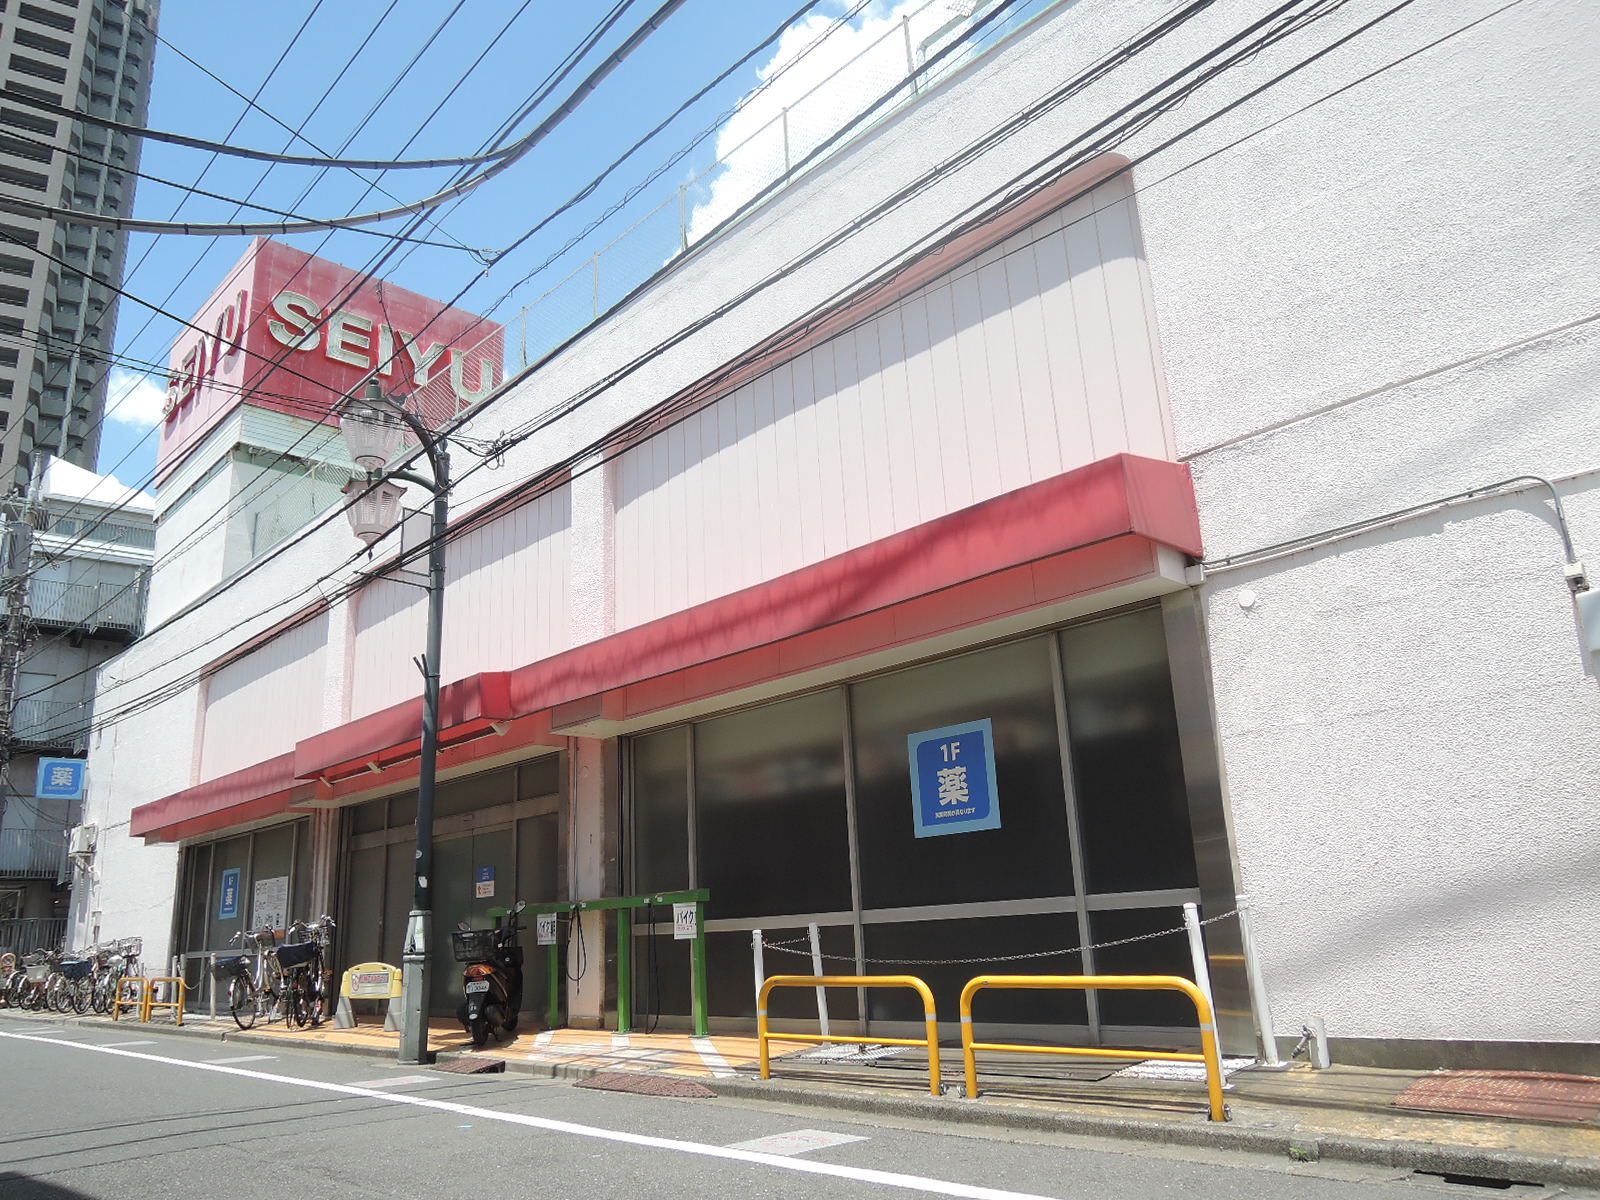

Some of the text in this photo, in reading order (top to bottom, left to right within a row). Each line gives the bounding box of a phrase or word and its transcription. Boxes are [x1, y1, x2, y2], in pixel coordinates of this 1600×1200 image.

[268, 290, 494, 403] SEIYU
[940, 741, 960, 762] 1F
[51, 766, 74, 786] 薬
[937, 765, 969, 806] 薬
